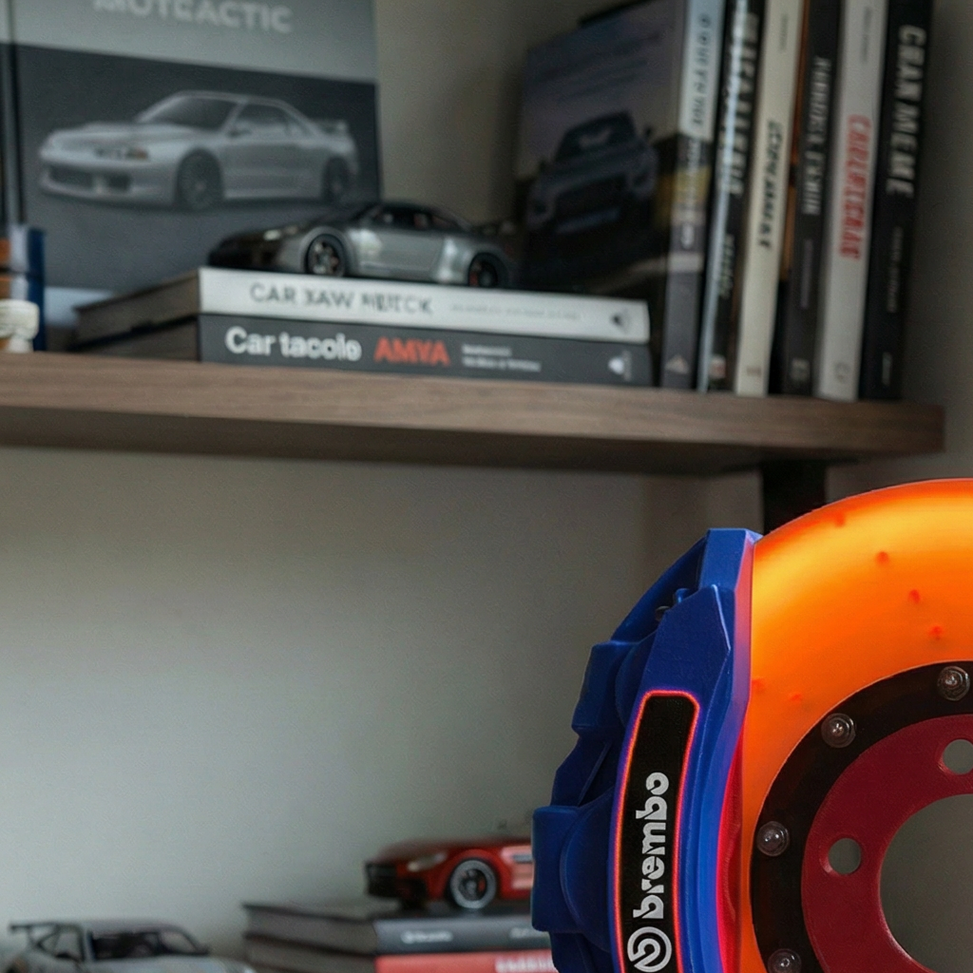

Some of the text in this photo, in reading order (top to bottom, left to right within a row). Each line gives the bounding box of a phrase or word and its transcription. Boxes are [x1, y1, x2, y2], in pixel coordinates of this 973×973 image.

[250, 283, 297, 305] CAR
[225, 326, 275, 356] Car
[632, 772, 669, 919] brembo
